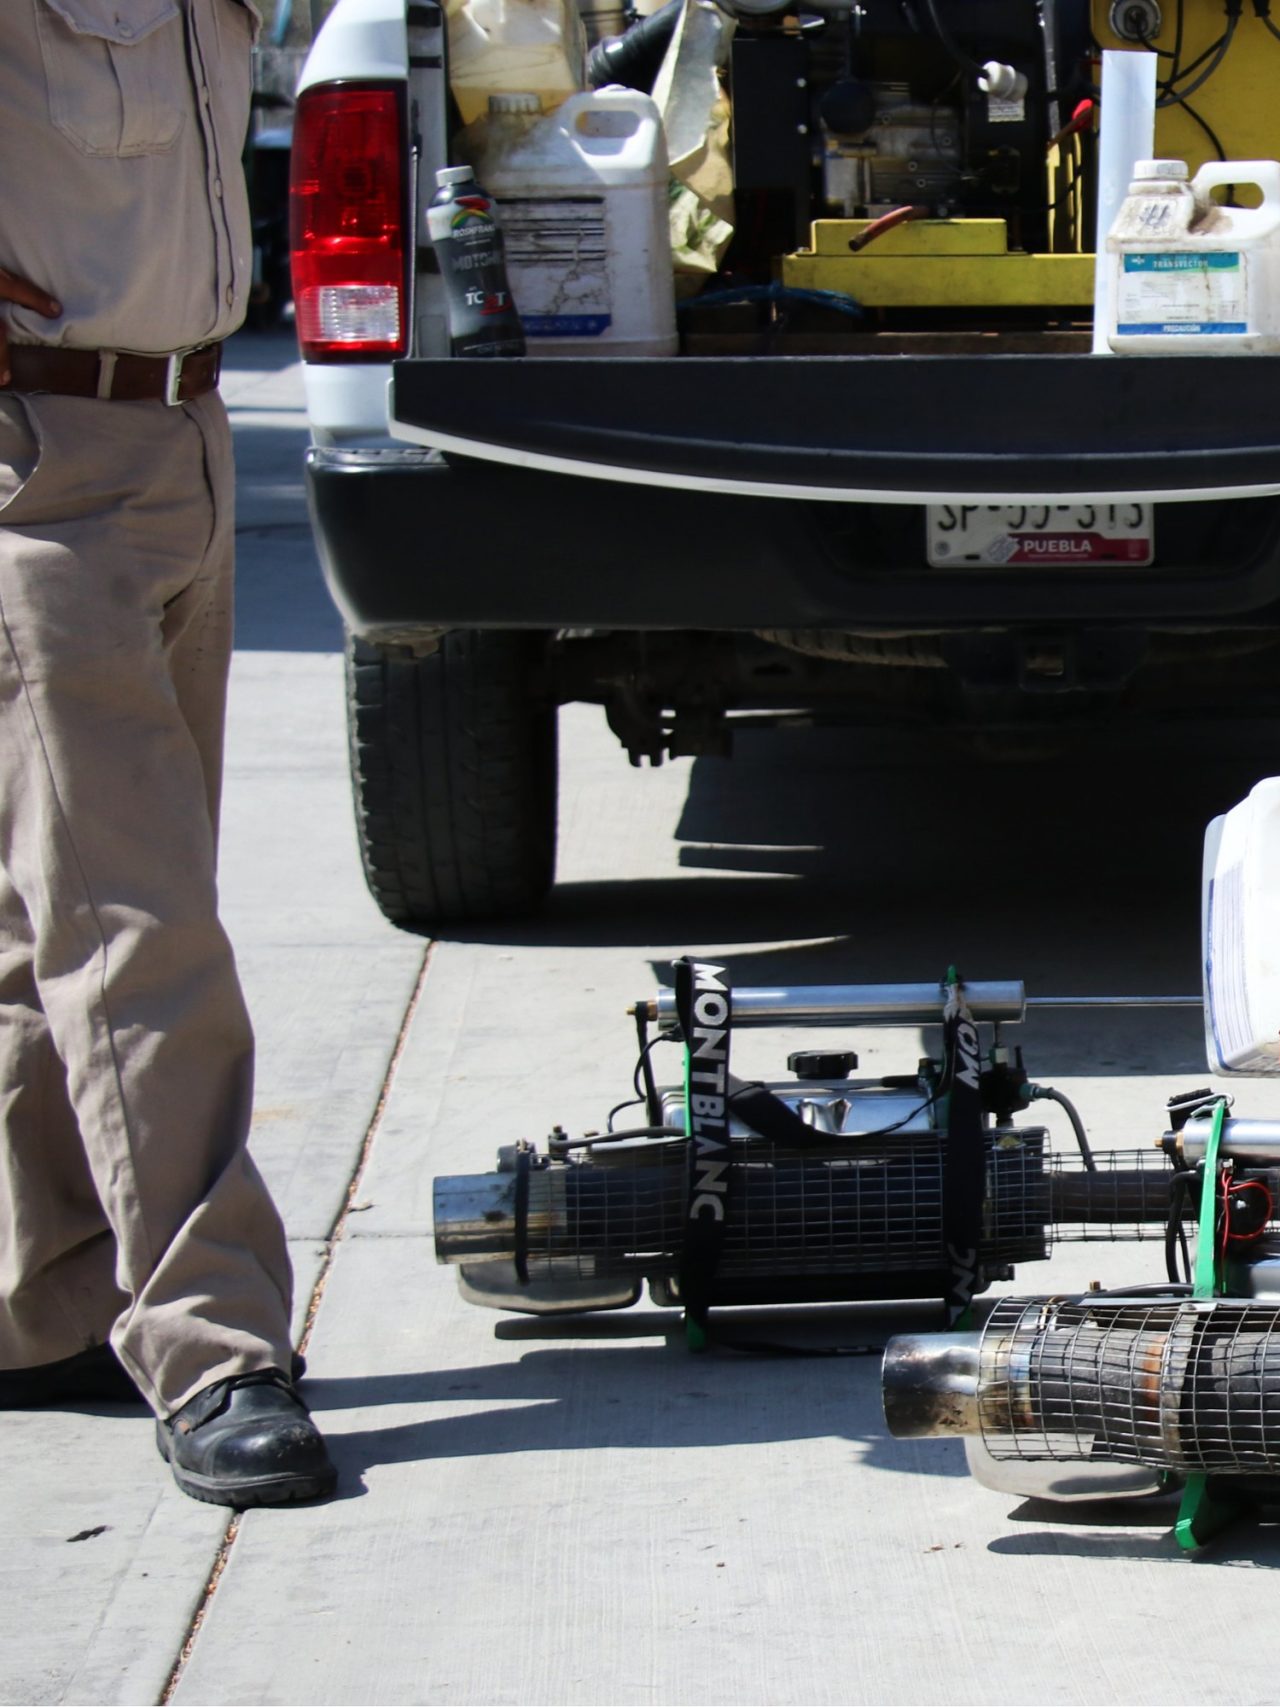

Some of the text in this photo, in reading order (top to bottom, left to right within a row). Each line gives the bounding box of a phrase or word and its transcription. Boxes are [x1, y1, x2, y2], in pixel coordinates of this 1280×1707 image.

[465, 290, 484, 305] TC
[1023, 540, 1093, 553] PUEBLA
[690, 963, 729, 1221] MONTBLANC
